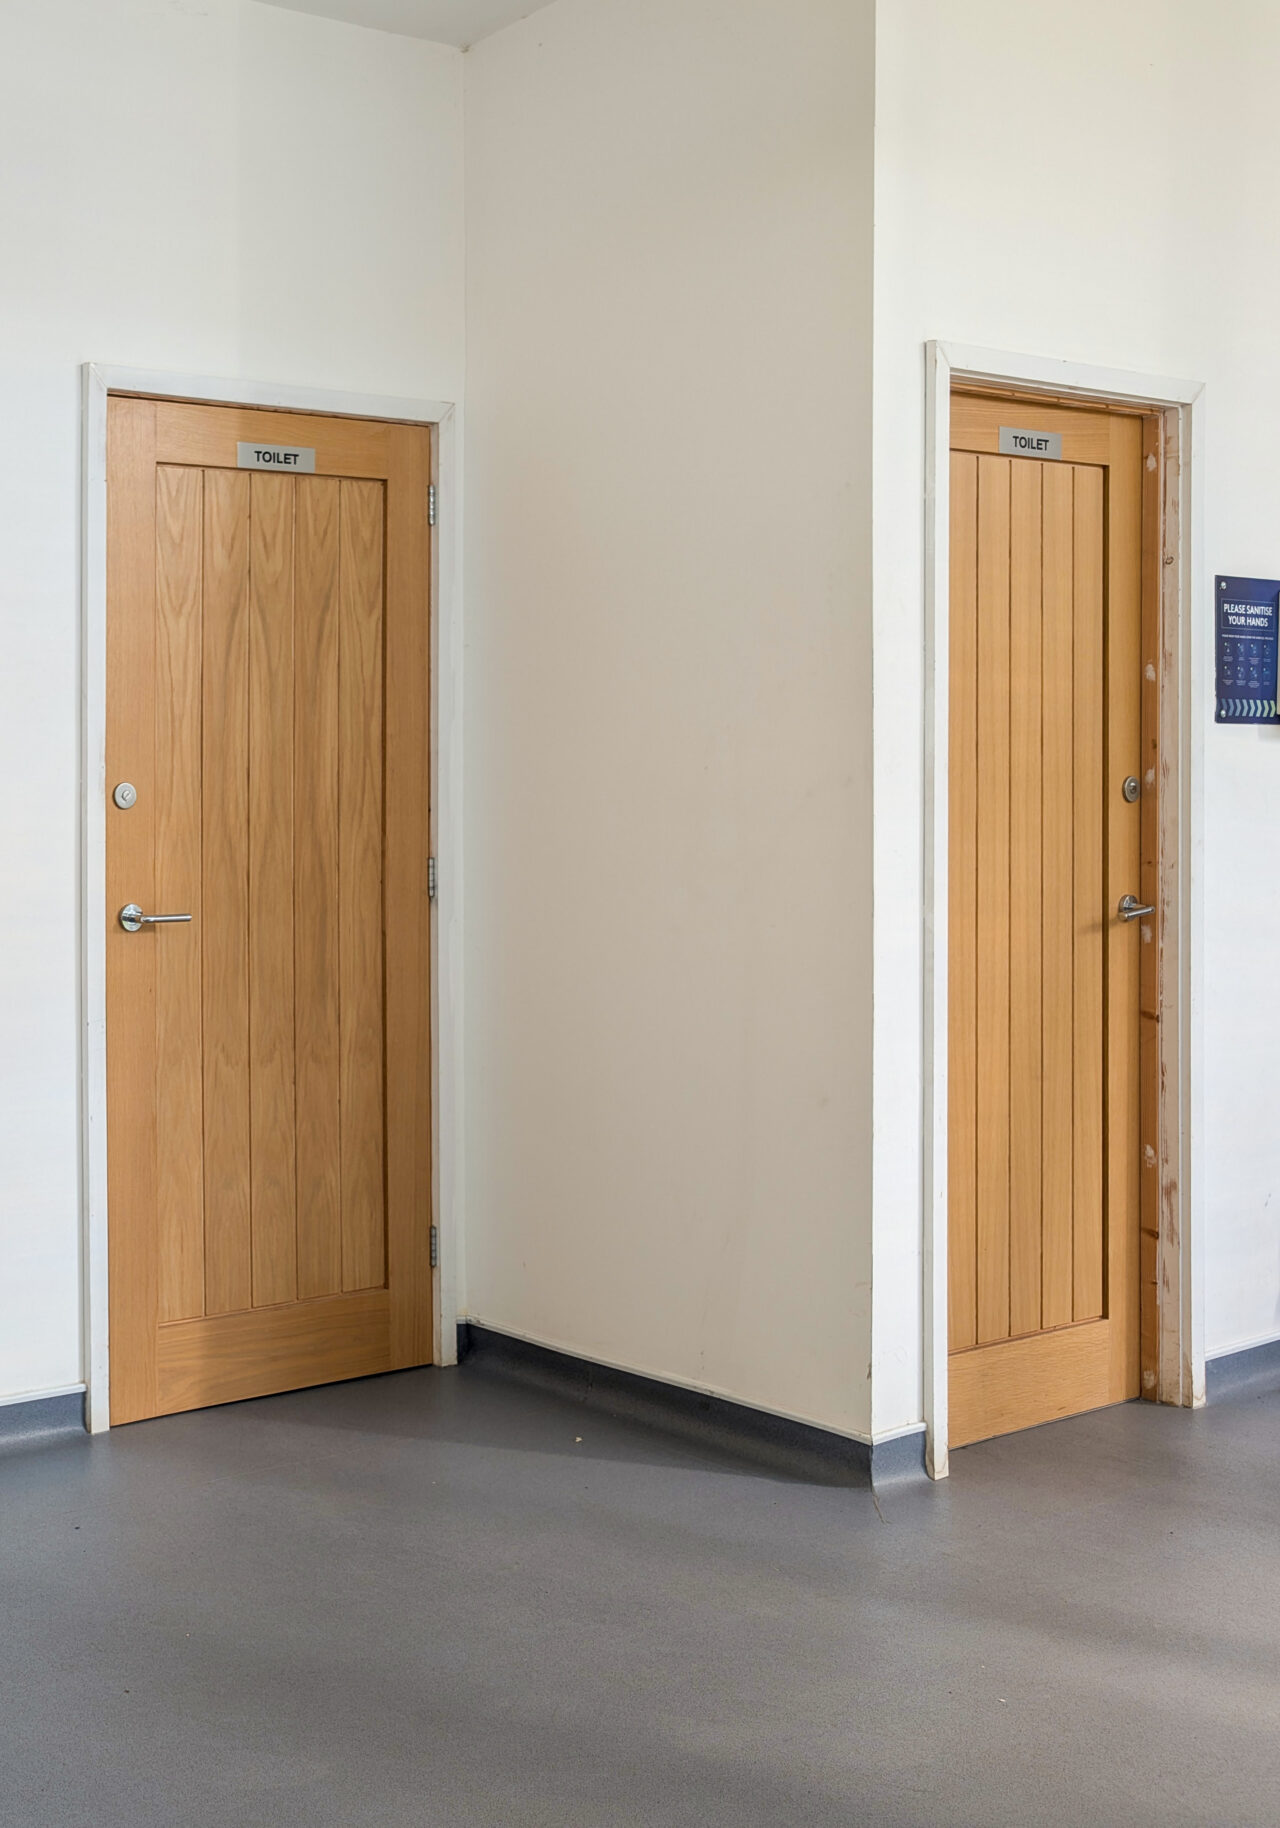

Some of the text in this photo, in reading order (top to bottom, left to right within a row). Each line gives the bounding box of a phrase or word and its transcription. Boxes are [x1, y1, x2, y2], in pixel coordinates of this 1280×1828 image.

[1012, 435, 1049, 451] TOILET
[254, 450, 299, 465] TOILET
[1223, 603, 1273, 616] PLEASE SANITISE
[1227, 615, 1269, 627] YOUR HANDS
